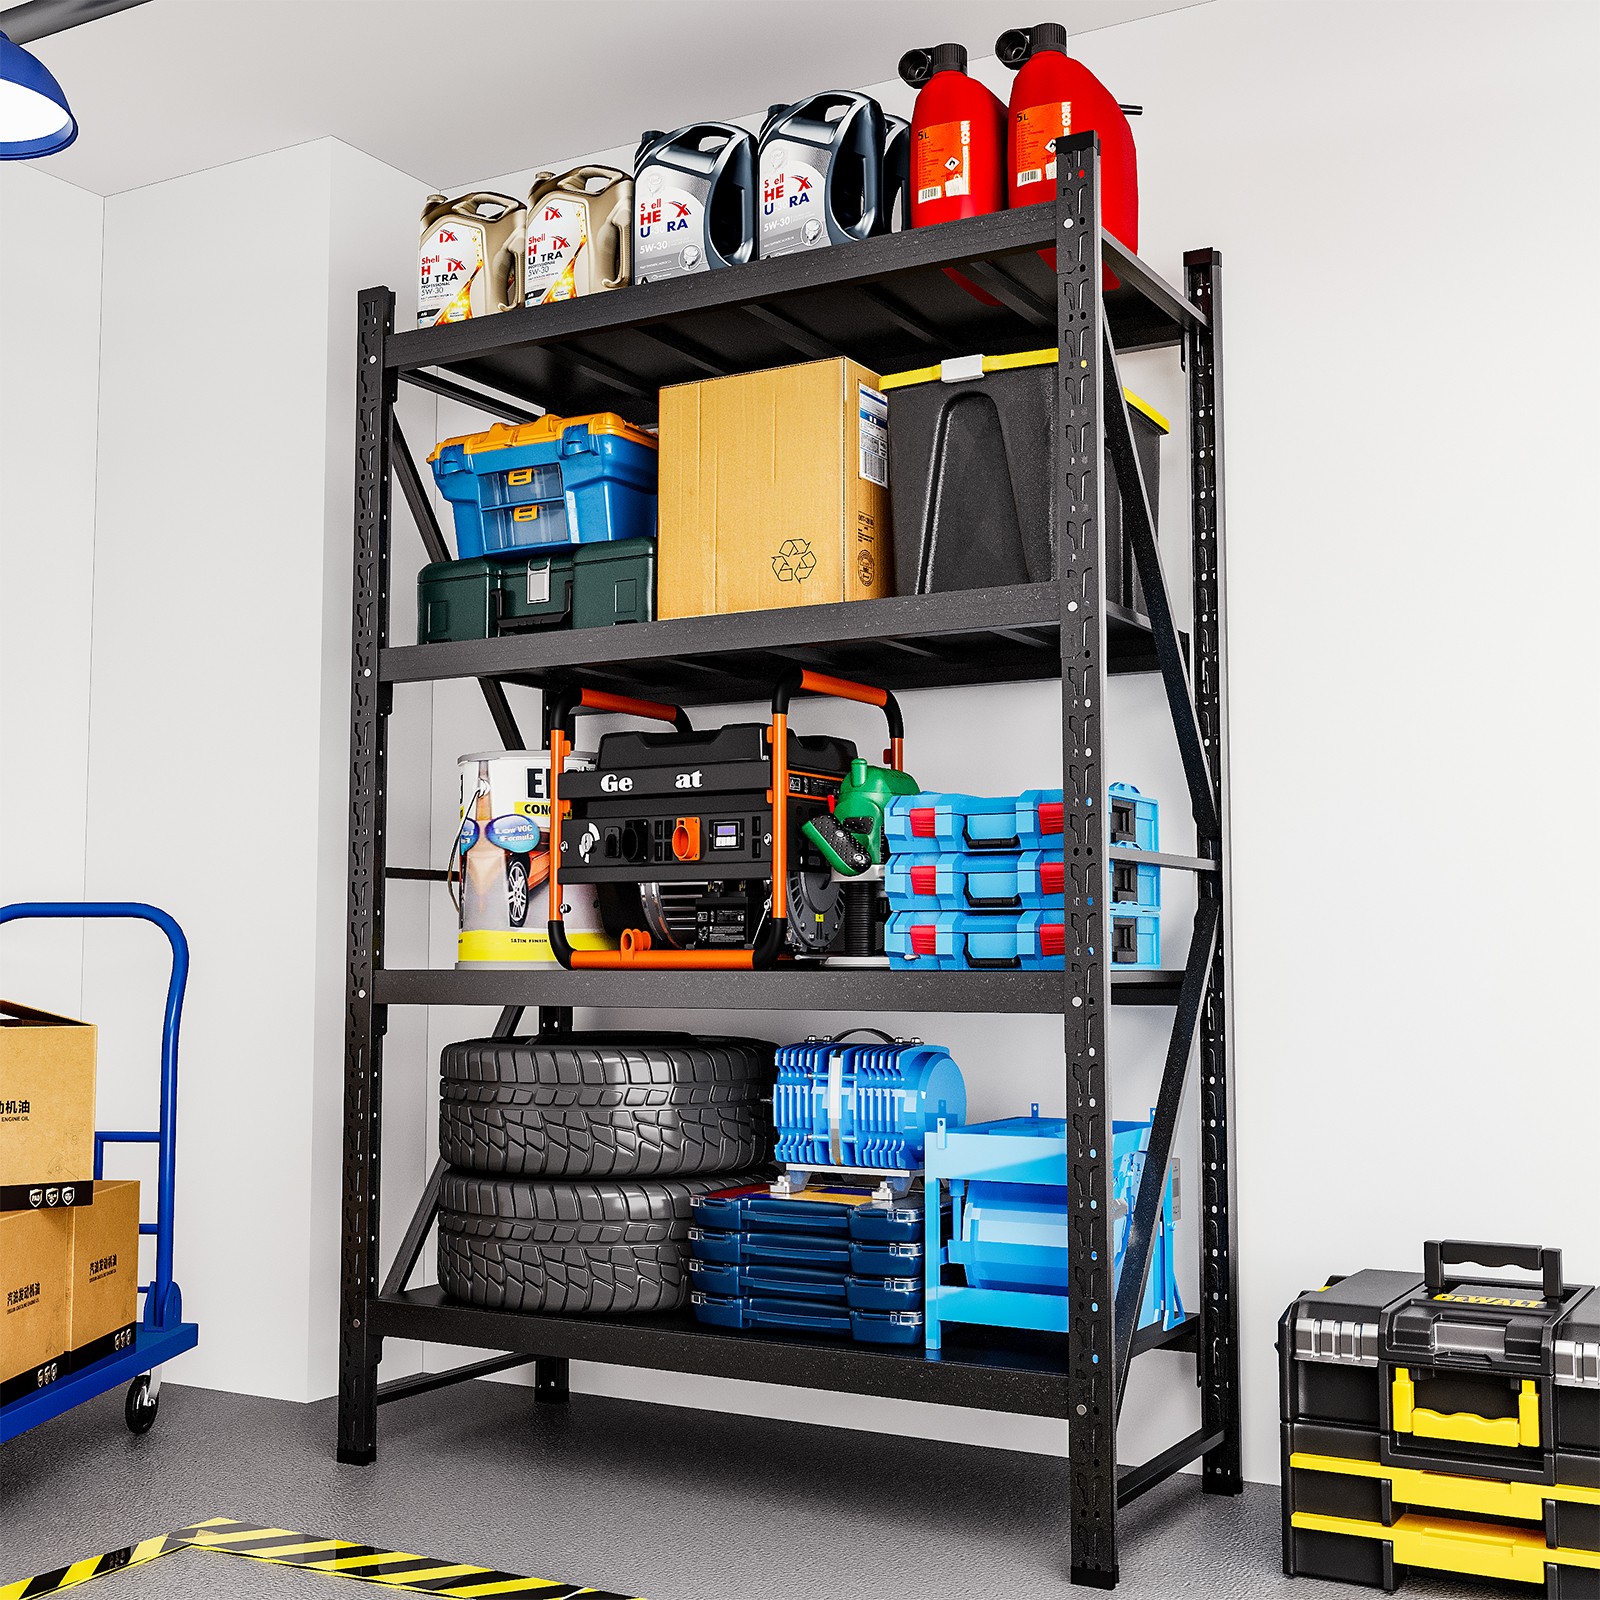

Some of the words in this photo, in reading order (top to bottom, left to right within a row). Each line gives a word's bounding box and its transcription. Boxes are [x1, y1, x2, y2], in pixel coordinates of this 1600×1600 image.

[764, 203, 774, 215] U
[789, 192, 810, 208] RA
[640, 226, 651, 238] U
[667, 218, 688, 232] RA
[763, 216, 790, 232] 5W-30
[528, 233, 546, 246] Shell
[639, 241, 668, 254] 5W-30
[421, 255, 440, 265] Shell
[541, 251, 563, 262] TRA
[528, 266, 549, 277] 5W-30
[435, 273, 458, 282] TRA
[421, 287, 443, 297] 5W-30
[517, 824, 533, 833] VOC
[500, 833, 534, 842] Formula
[7, 1281, 40, 1307] 汽油发动机油
